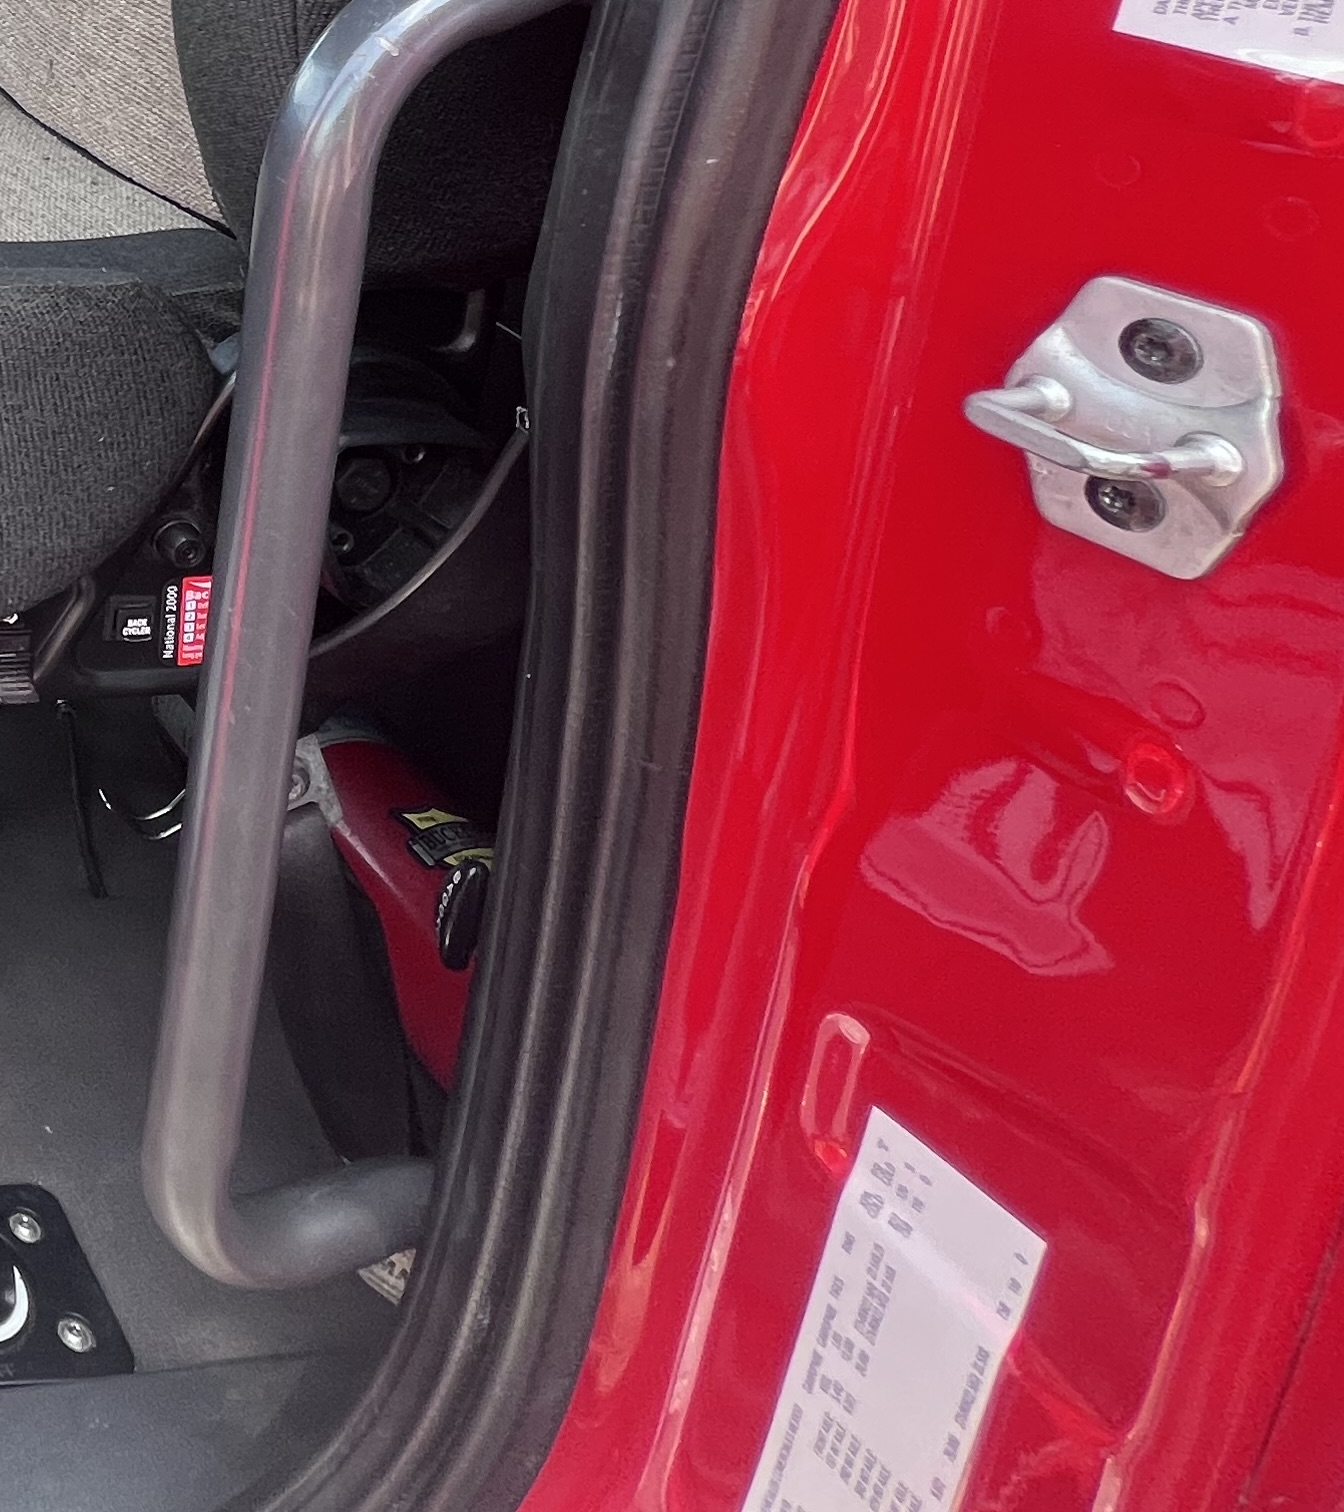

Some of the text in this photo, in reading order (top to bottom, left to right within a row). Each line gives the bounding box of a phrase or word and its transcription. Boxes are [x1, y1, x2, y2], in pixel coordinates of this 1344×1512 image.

[186, 590, 209, 600] Bac
[127, 619, 147, 627] BACK
[123, 627, 151, 636] CYCLER
[162, 614, 176, 658] National
